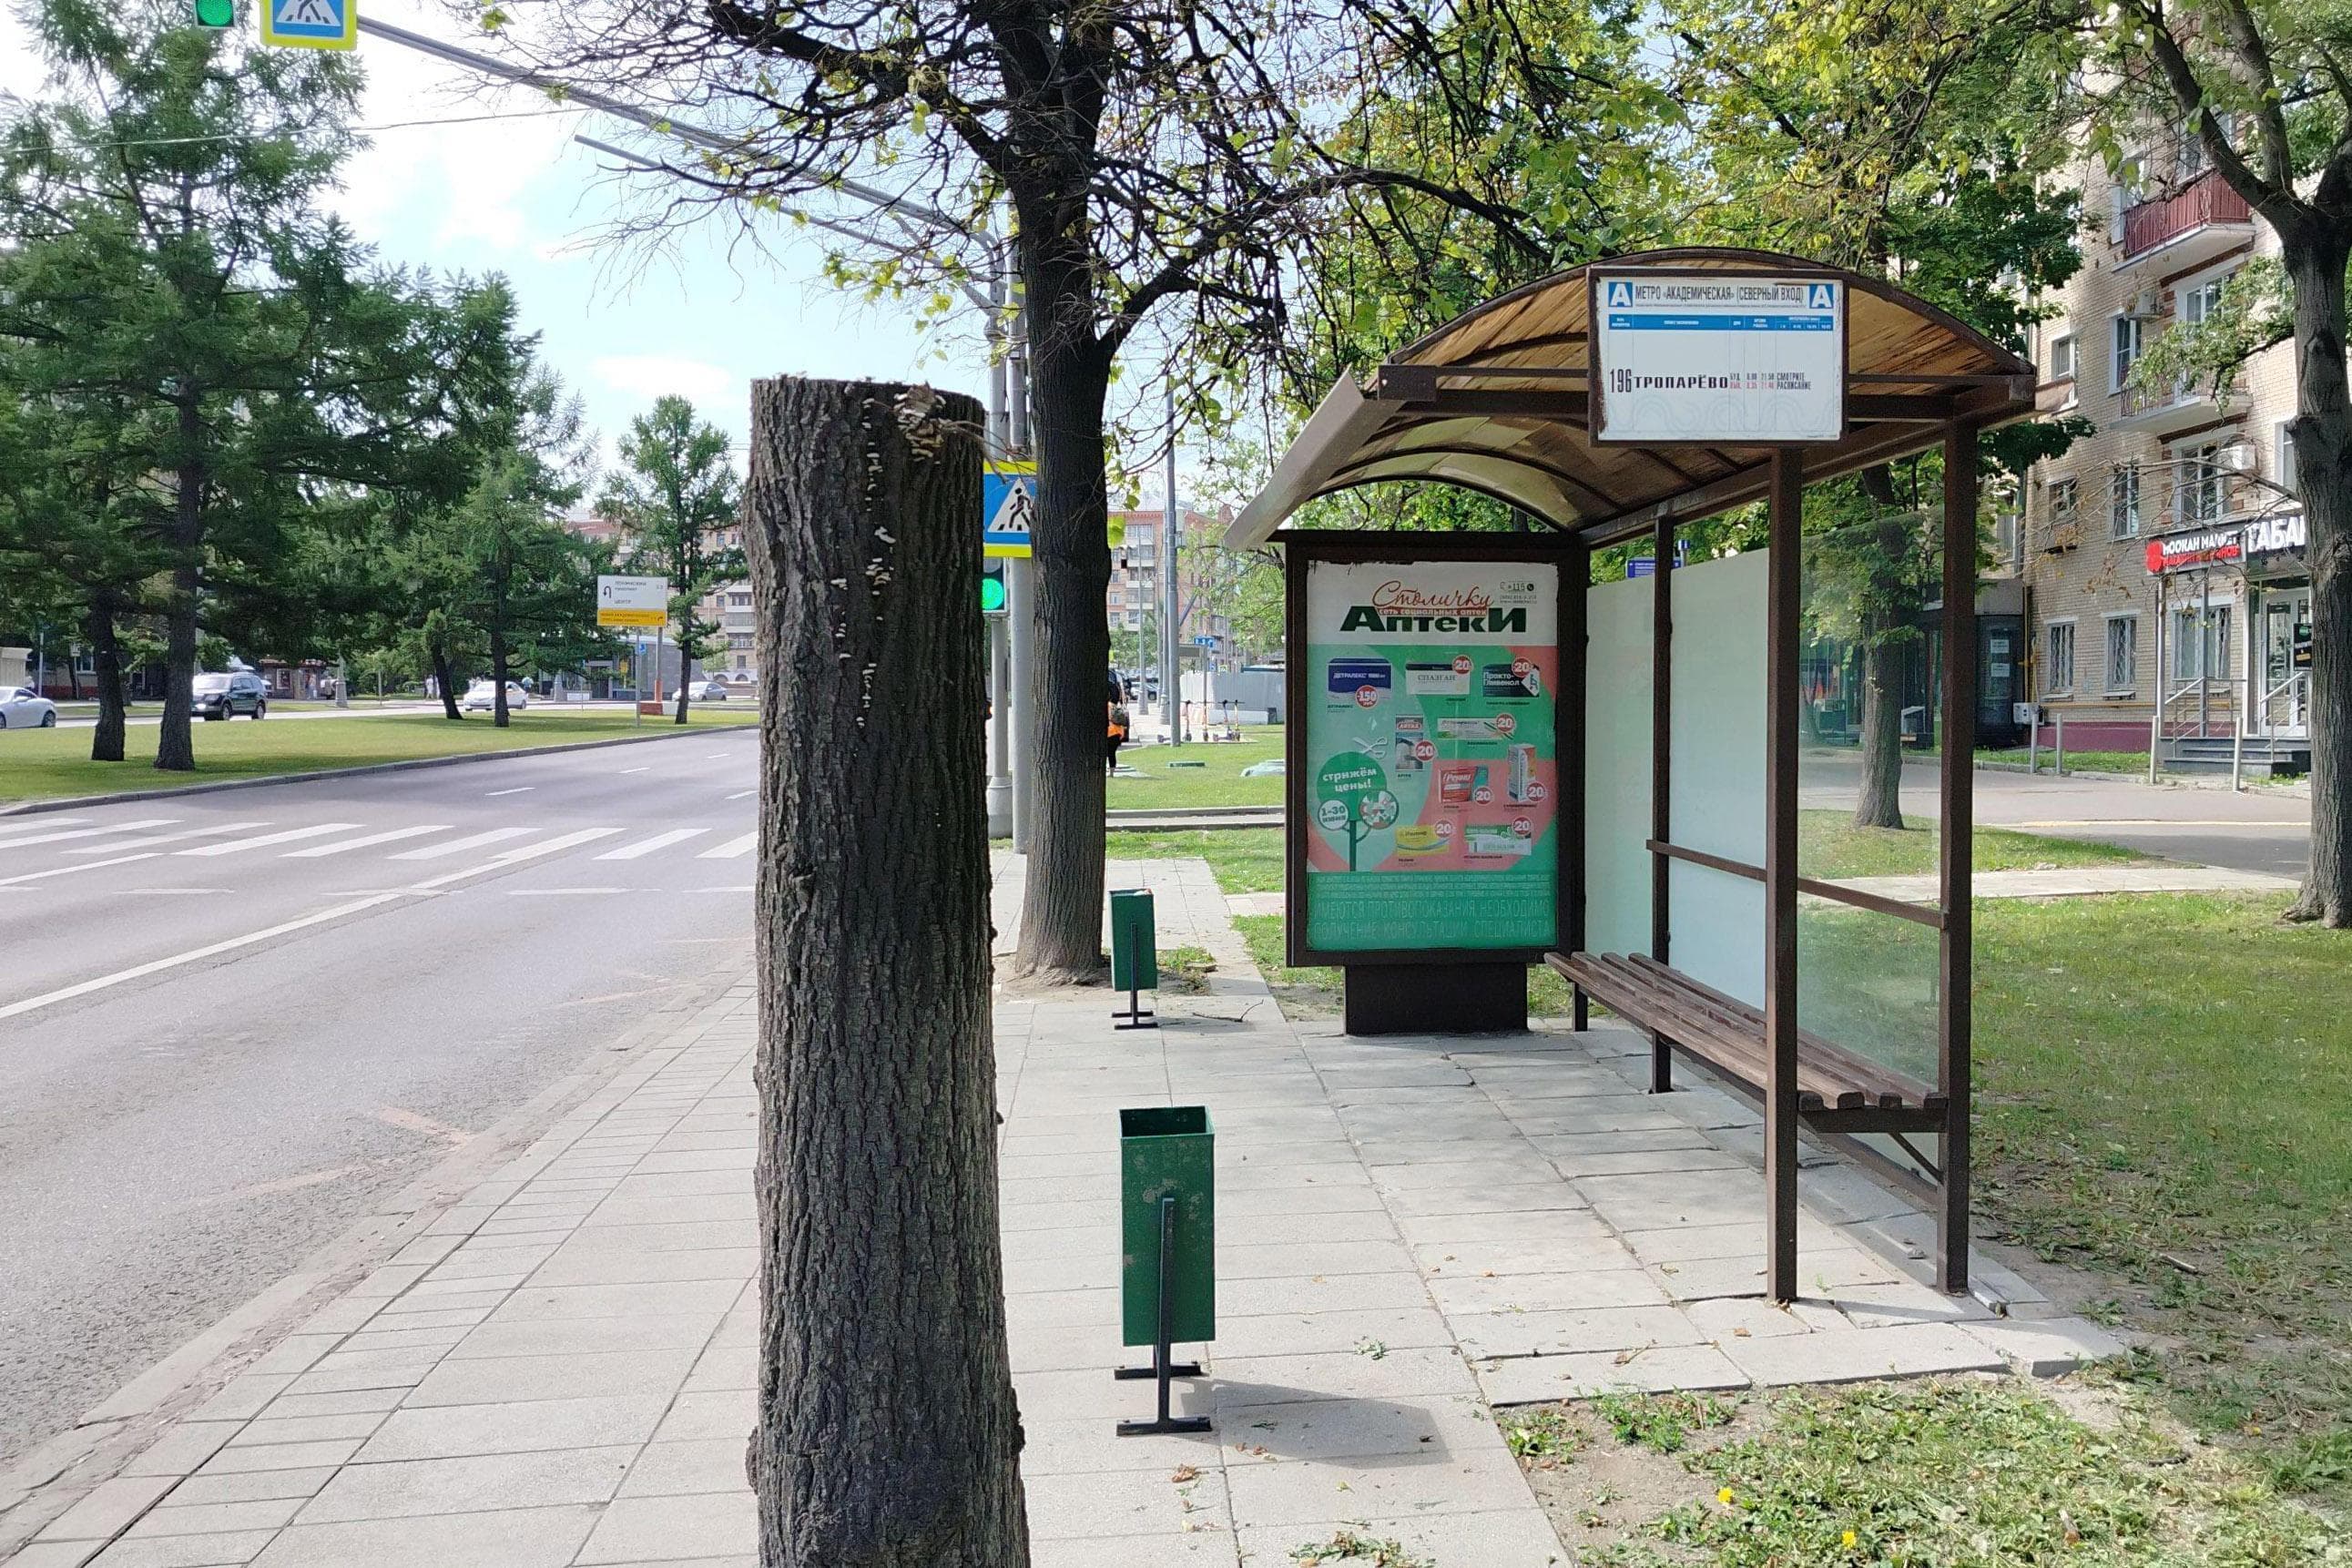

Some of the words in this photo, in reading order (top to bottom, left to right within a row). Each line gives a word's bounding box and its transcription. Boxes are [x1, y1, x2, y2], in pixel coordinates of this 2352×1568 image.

[1635, 286, 1661, 300] МЕТРО
[1736, 286, 1779, 302] (СЕВЕРНЫЙ
[1781, 287, 1804, 303] ВХОД)
[1610, 369, 1632, 392] 196
[1634, 374, 1728, 389] ТРОПАРЁВО
[1777, 372, 1805, 381] СМОТРИТЕ
[1777, 382, 1811, 391] РАСПИСАНИЕ
[2245, 515, 2306, 553] ТАБА
[1372, 580, 1494, 606] Столички
[1400, 608, 1457, 616] социальных
[1322, 767, 1377, 783] стрижём
[1335, 779, 1371, 793] цены!
[1321, 806, 1346, 817] 1-30
